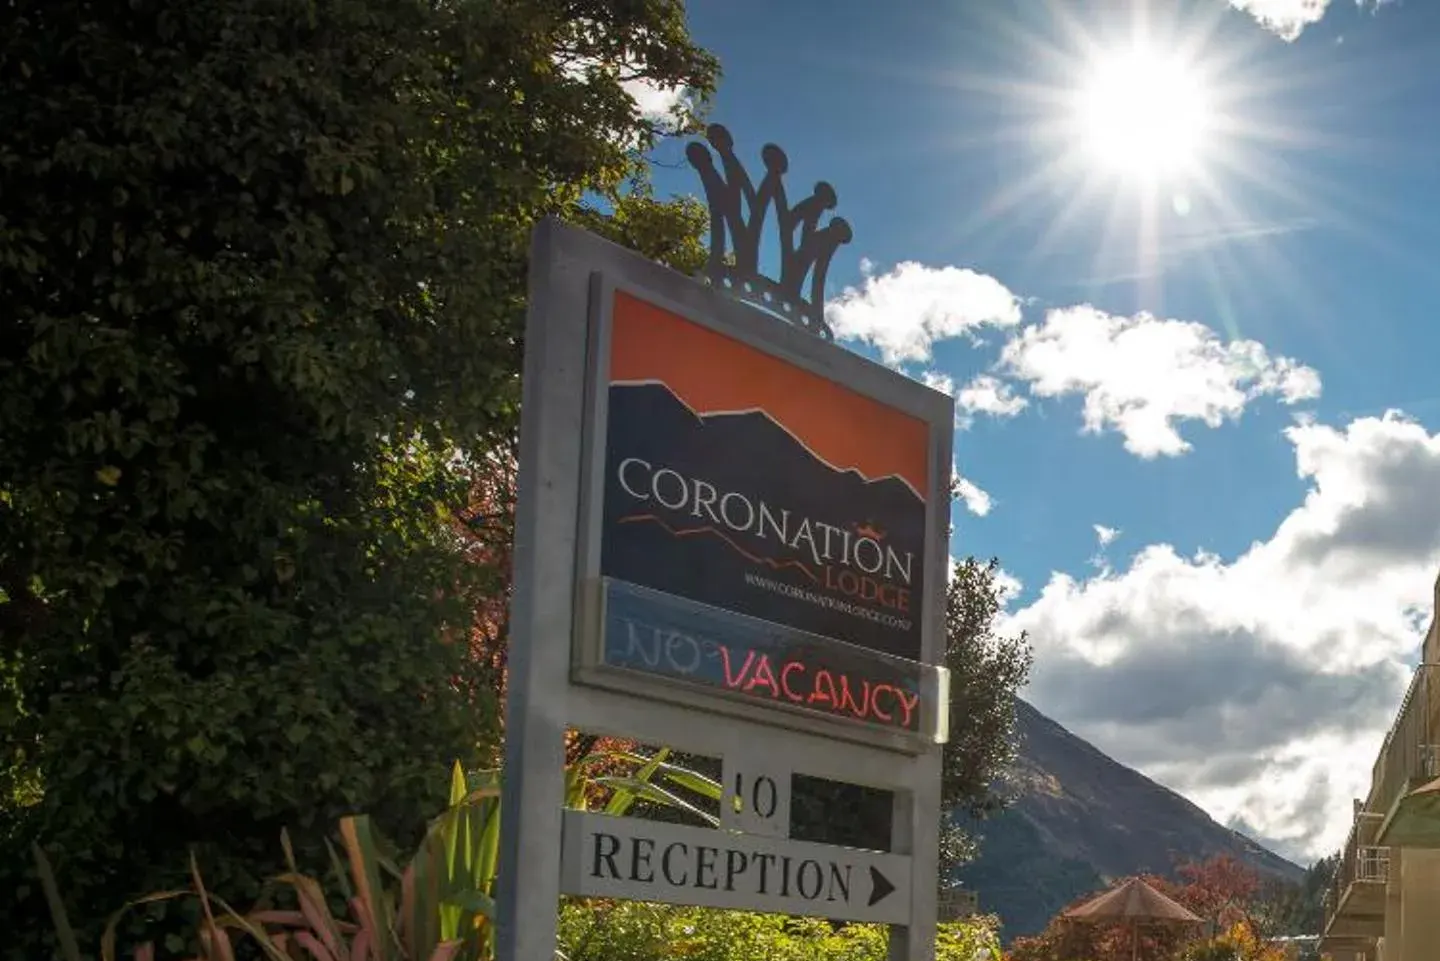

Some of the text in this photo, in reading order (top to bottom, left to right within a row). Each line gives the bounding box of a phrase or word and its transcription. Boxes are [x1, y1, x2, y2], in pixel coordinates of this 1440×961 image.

[618, 458, 913, 584] CORONATION
[825, 565, 911, 613] LODGE
[621, 621, 919, 726] NO VACANCY
[734, 772, 778, 819] 10
[590, 832, 853, 905] RECEPTION
